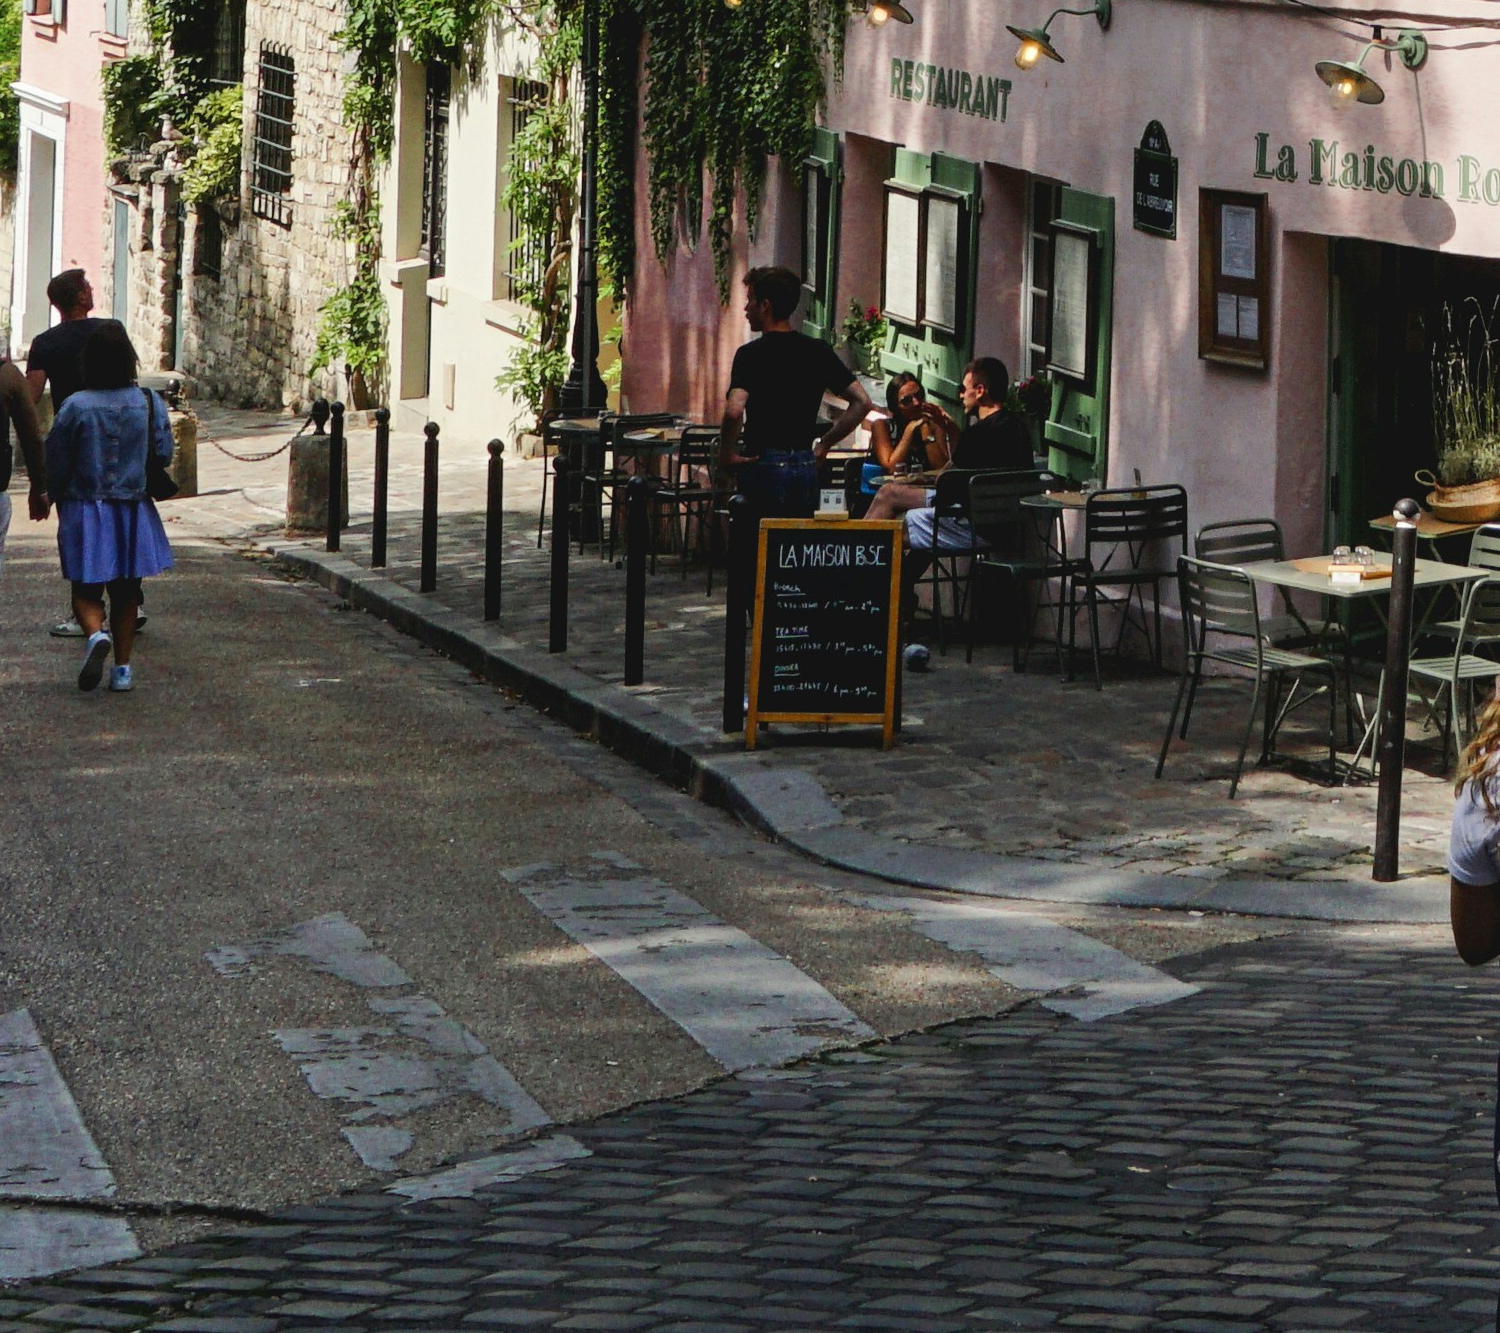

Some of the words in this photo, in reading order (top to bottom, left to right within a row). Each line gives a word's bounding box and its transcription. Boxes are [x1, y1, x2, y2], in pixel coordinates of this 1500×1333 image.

[890, 57, 1012, 123] RESTAURANT
[1253, 132, 1298, 182] La
[1309, 138, 1445, 200] Maison
[779, 544, 798, 568] LA
